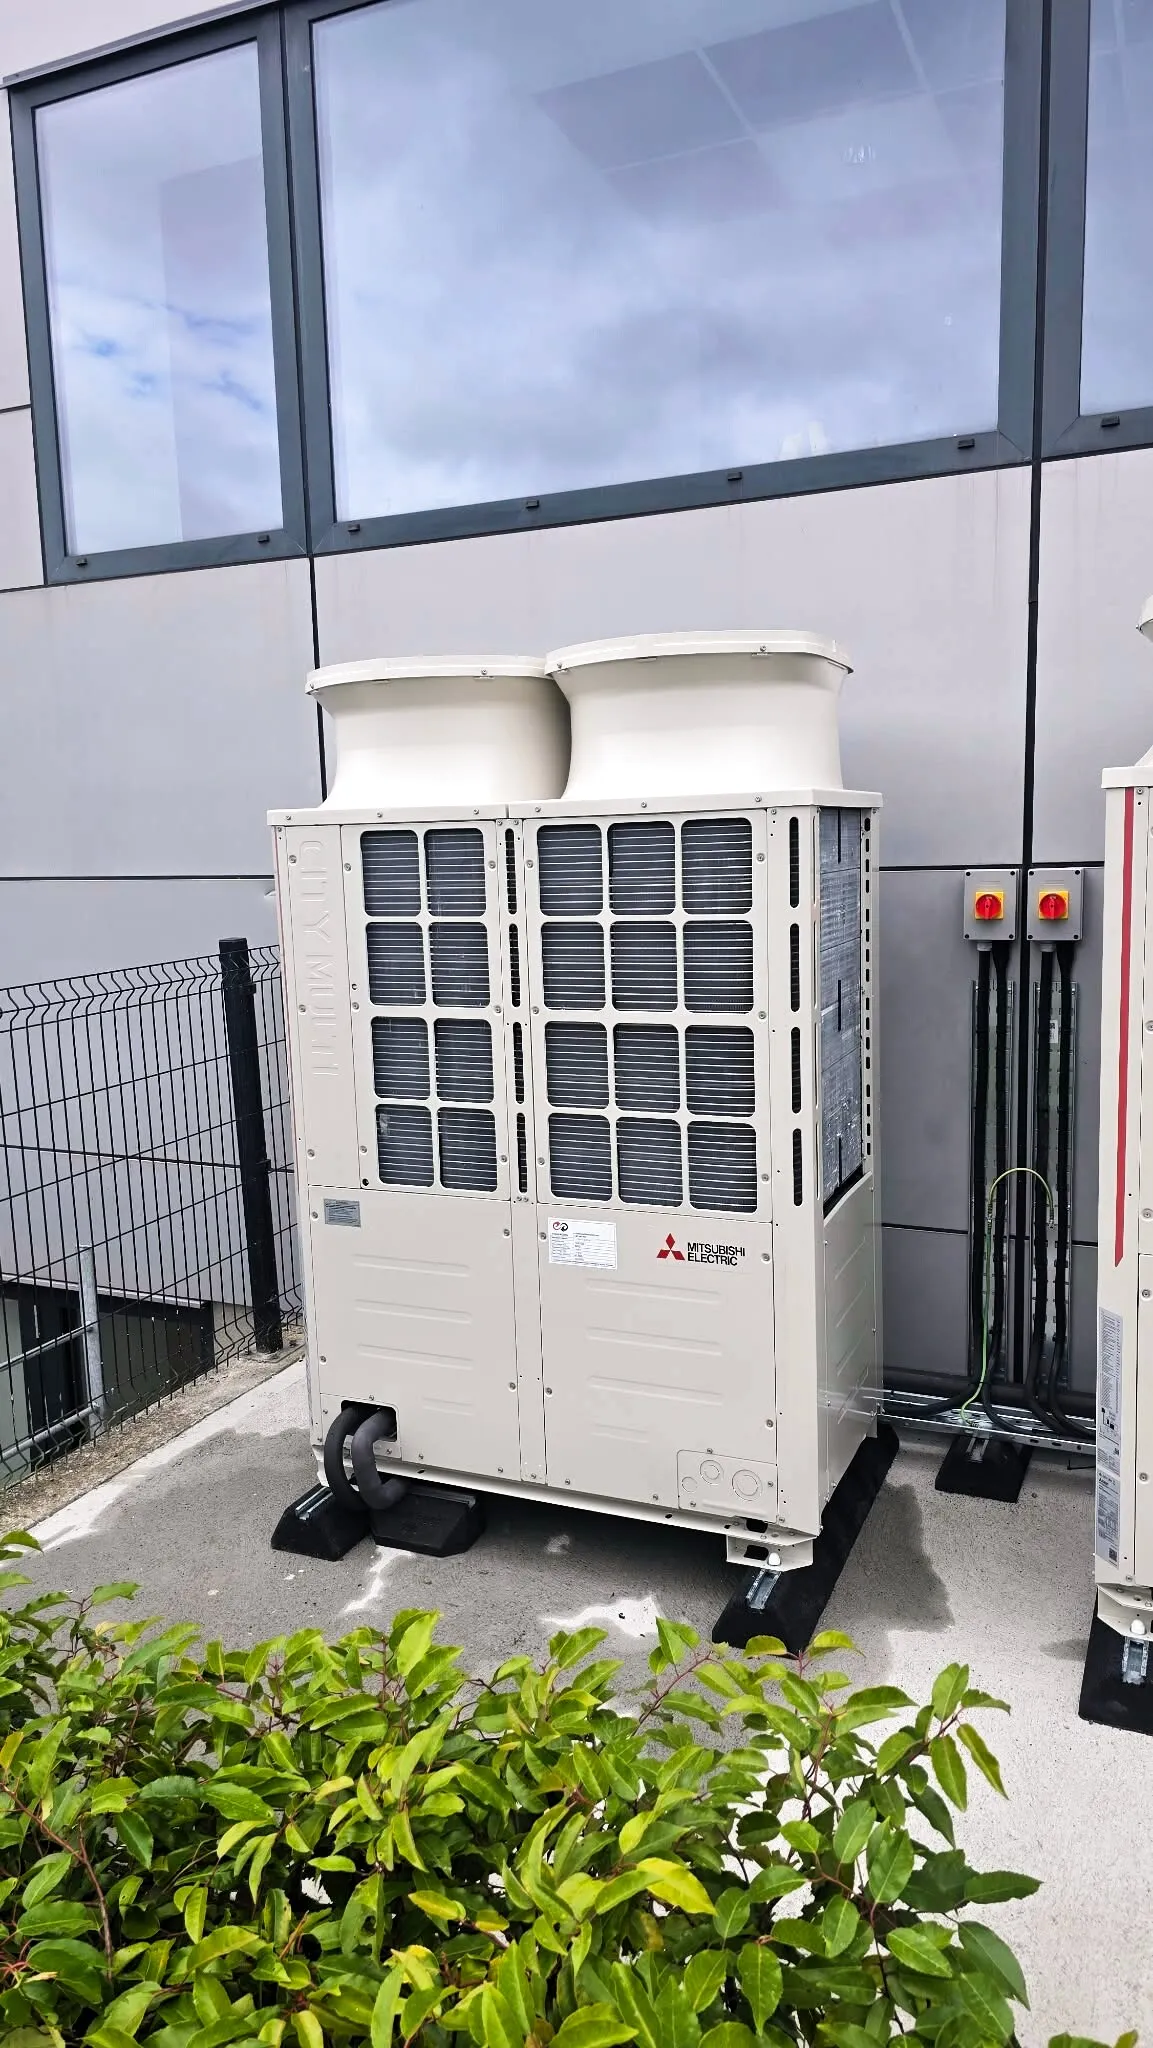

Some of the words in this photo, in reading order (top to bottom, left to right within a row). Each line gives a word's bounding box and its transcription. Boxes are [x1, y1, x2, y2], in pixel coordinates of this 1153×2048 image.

[300, 840, 332, 943] CITY
[687, 1242, 746, 1257] MITSUBISHI
[687, 1251, 738, 1266] ELECTRIC
